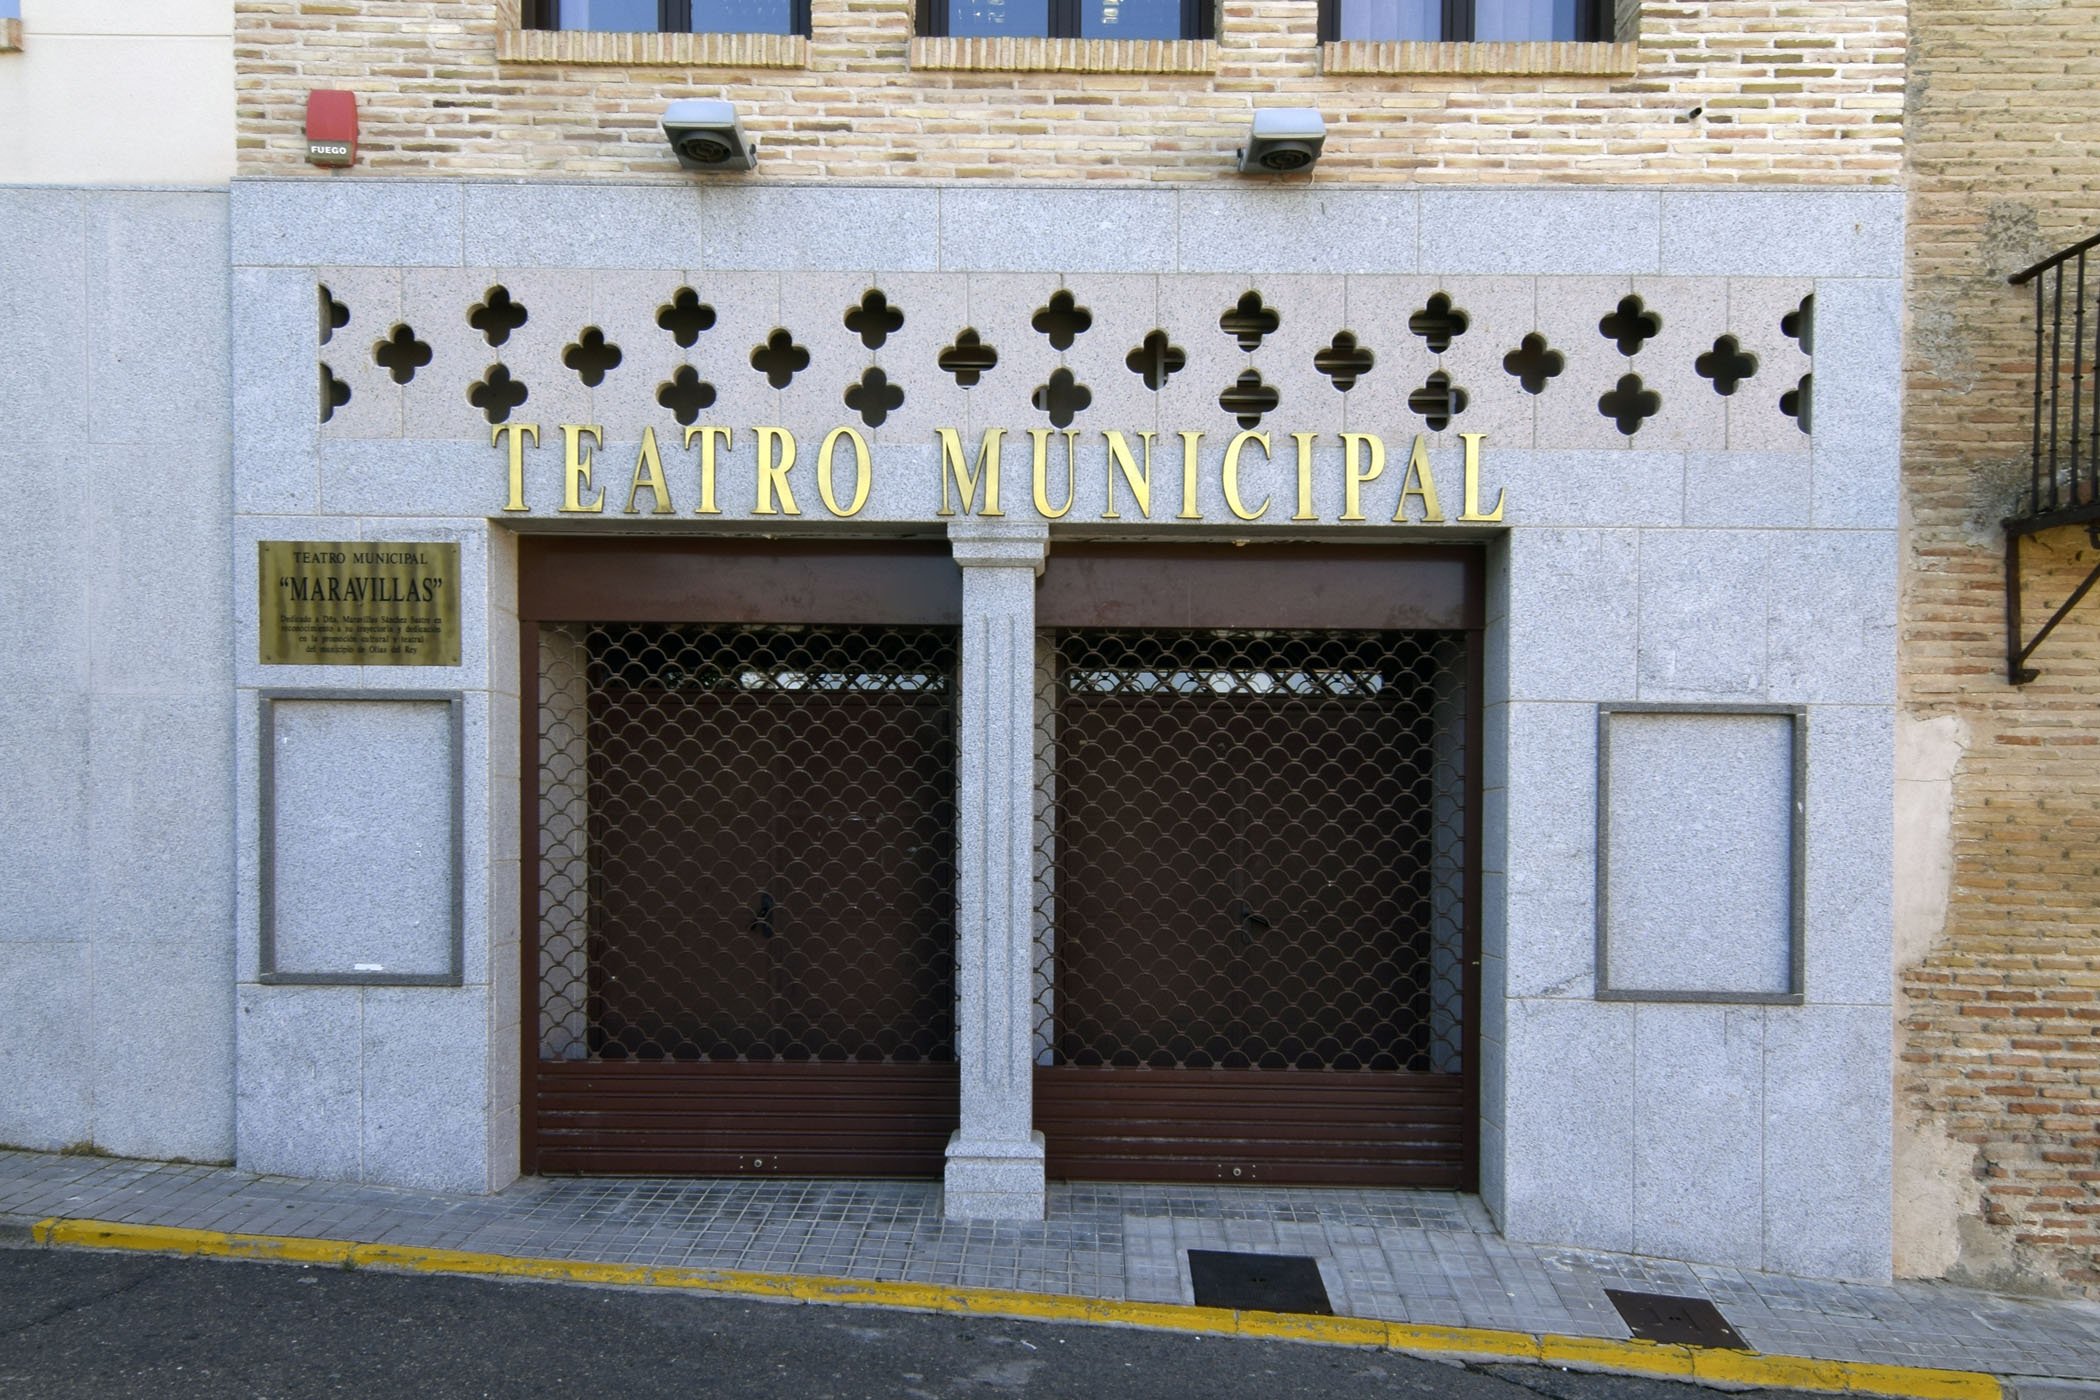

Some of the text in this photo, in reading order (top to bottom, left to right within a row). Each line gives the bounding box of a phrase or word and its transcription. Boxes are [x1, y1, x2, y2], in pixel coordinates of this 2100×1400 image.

[311, 145, 347, 155] FUEGO
[491, 423, 1505, 522] TEATRO MUNICIPAL
[294, 552, 428, 565] TEATRO MUNICIPAL
